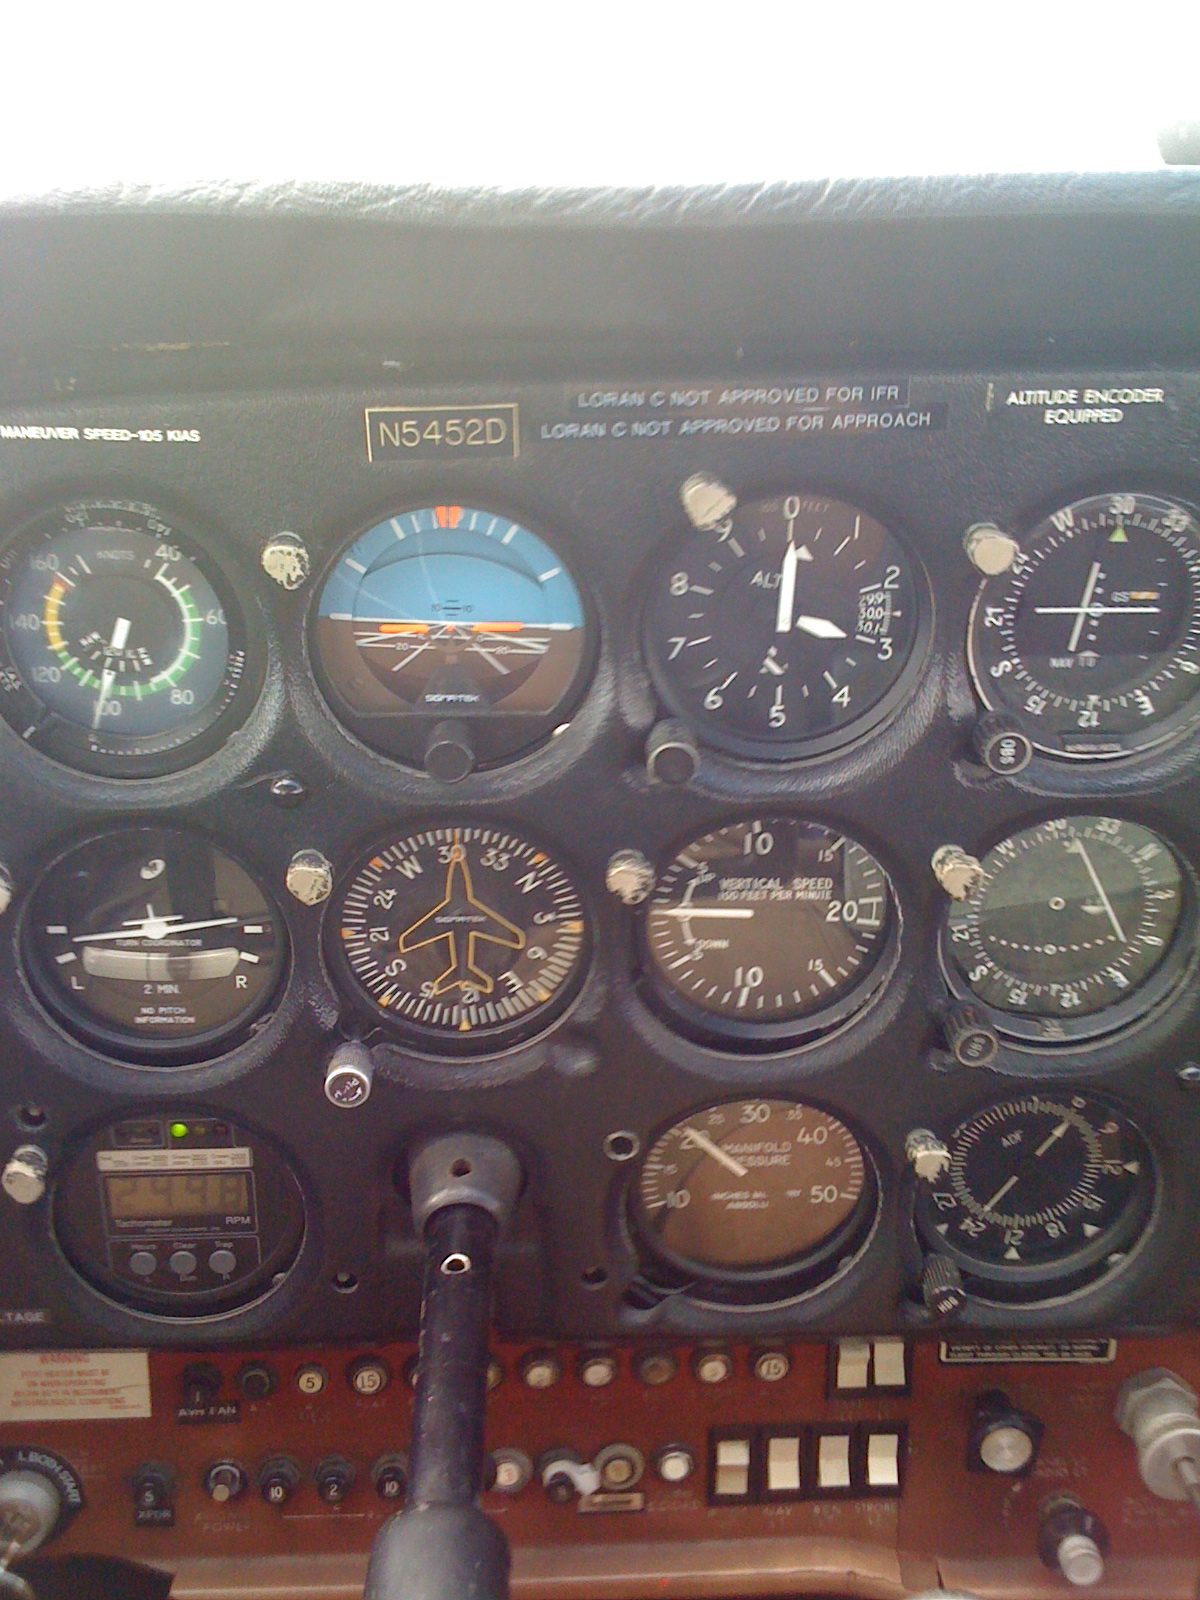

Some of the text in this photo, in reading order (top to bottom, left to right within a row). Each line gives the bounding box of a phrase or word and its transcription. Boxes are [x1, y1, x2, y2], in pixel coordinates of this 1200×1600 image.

[577, 385, 899, 408] LORAN C NOT APPROVED FOR IFR
[1005, 388, 1165, 406] ALTITUDE ENCODER
[540, 412, 931, 439] LORAN C NOT APPROVED FOR APPROACH
[1043, 407, 1124, 425] EQUIPPED
[0, 424, 79, 440] MANEUVER
[166, 429, 201, 443] KIAS
[379, 417, 507, 447] N5452D
[783, 496, 800, 520] 0
[1050, 507, 1076, 533] W
[669, 571, 689, 596] 8
[882, 565, 900, 589] 2
[667, 636, 688, 661] 7
[876, 637, 893, 661] 3
[990, 660, 1012, 678] S
[169, 690, 194, 705] 80
[703, 686, 723, 710] 6
[831, 685, 852, 708] 4
[768, 704, 786, 728] 5
[743, 832, 774, 855] 10
[479, 847, 512, 872] 33
[817, 849, 834, 862] 15
[395, 855, 424, 880] W
[514, 871, 544, 894] N
[717, 877, 834, 891] VERTICAL SPEED
[372, 887, 398, 911] 24
[532, 911, 557, 925] 3
[825, 900, 859, 923] 20
[369, 926, 390, 943] 21
[951, 923, 971, 943] 21
[526, 946, 548, 961] 6
[384, 958, 408, 978] S
[808, 958, 824, 971] 15
[968, 964, 989, 982] S
[70, 976, 86, 991] L
[235, 975, 248, 989] R
[497, 970, 525, 993] E
[733, 966, 764, 988] 10
[143, 983, 153, 995] 2
[140, 1006, 187, 1014] NO PITCH
[134, 1016, 196, 1025] INFORMATION
[739, 1103, 771, 1124] 30
[797, 1126, 828, 1146] 40
[733, 1154, 792, 1167] ESSURE
[666, 1189, 691, 1209] 10
[810, 1185, 838, 1205] 50
[225, 1216, 251, 1225] RPM
[305, 1376, 315, 1389] 5
[359, 1373, 377, 1389] 15
[269, 1485, 283, 1499] 10
[329, 1484, 339, 1496] 2
[384, 1481, 399, 1494] 10
